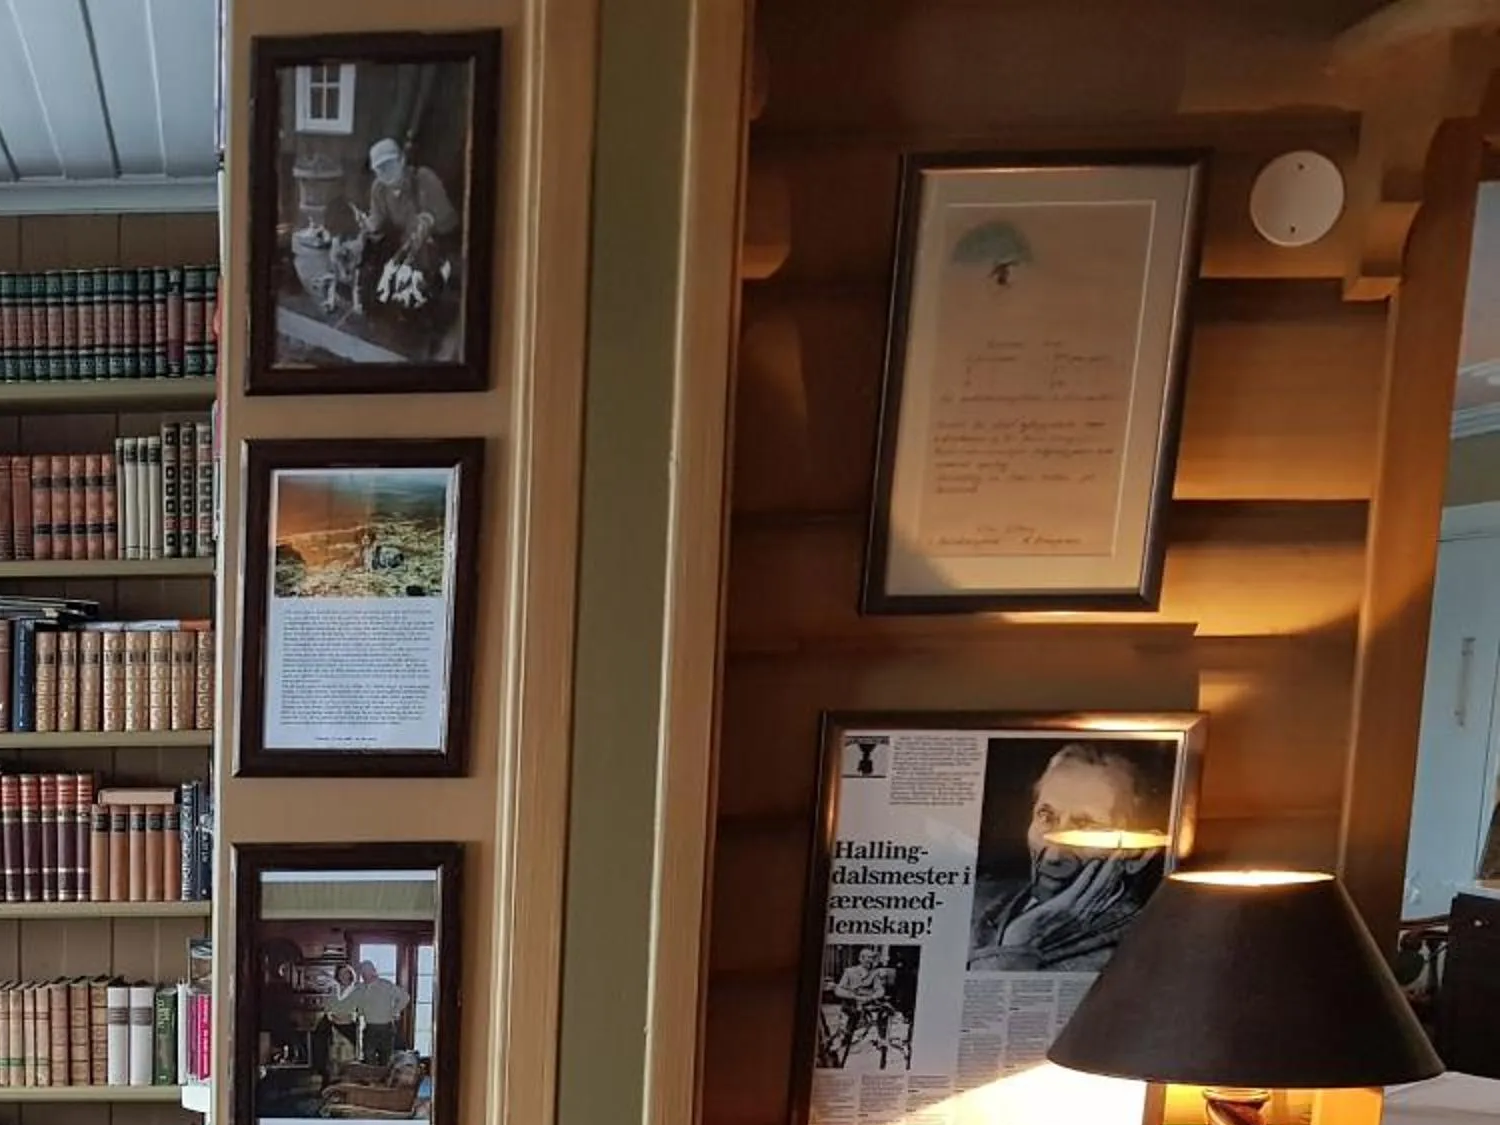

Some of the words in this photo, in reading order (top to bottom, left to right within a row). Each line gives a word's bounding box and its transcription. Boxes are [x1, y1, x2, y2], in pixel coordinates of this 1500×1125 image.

[835, 840, 929, 864] Halling-
[831, 866, 959, 885] dalsmester
[963, 866, 971, 885] i
[829, 891, 944, 910] æresmed-
[827, 916, 933, 938] lemskap!
